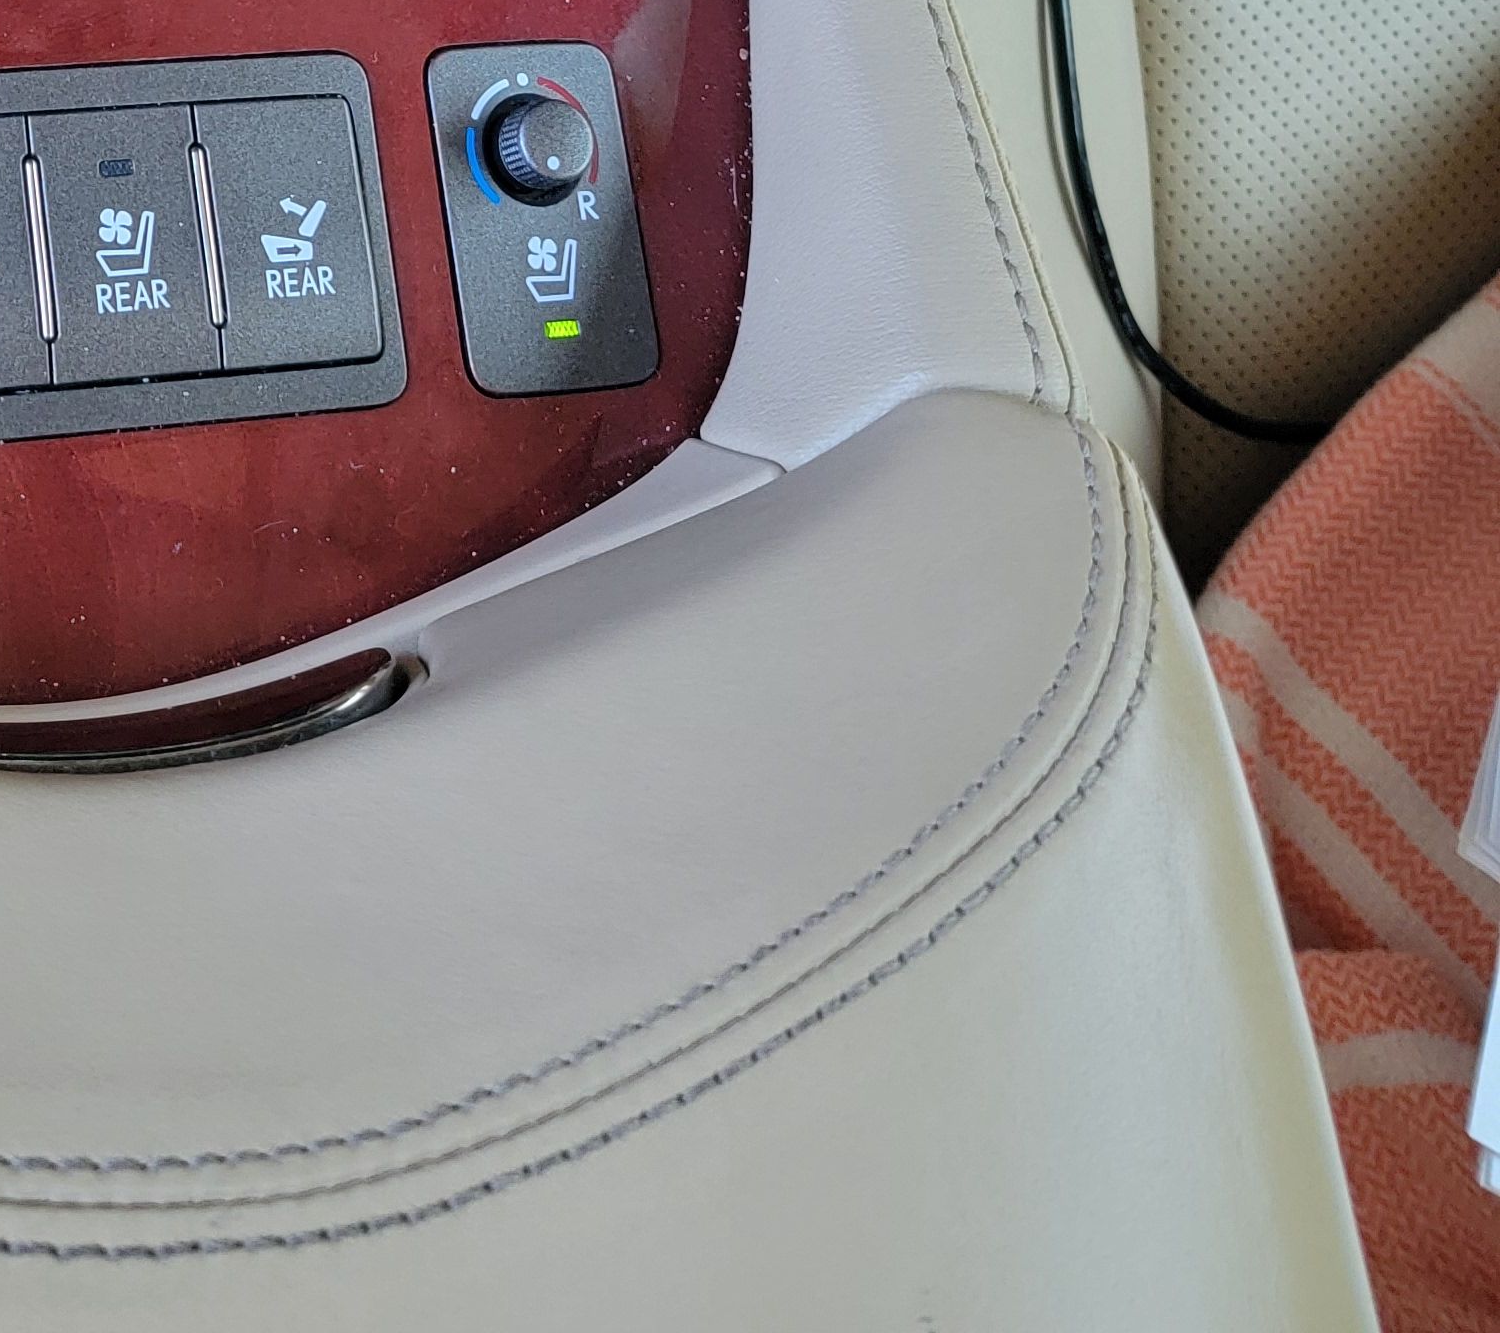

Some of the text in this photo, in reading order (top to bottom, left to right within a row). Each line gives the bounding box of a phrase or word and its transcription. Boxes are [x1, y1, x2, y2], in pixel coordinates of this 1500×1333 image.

[577, 190, 600, 221] R
[95, 279, 172, 315] REAR
[266, 264, 337, 299] REAR
